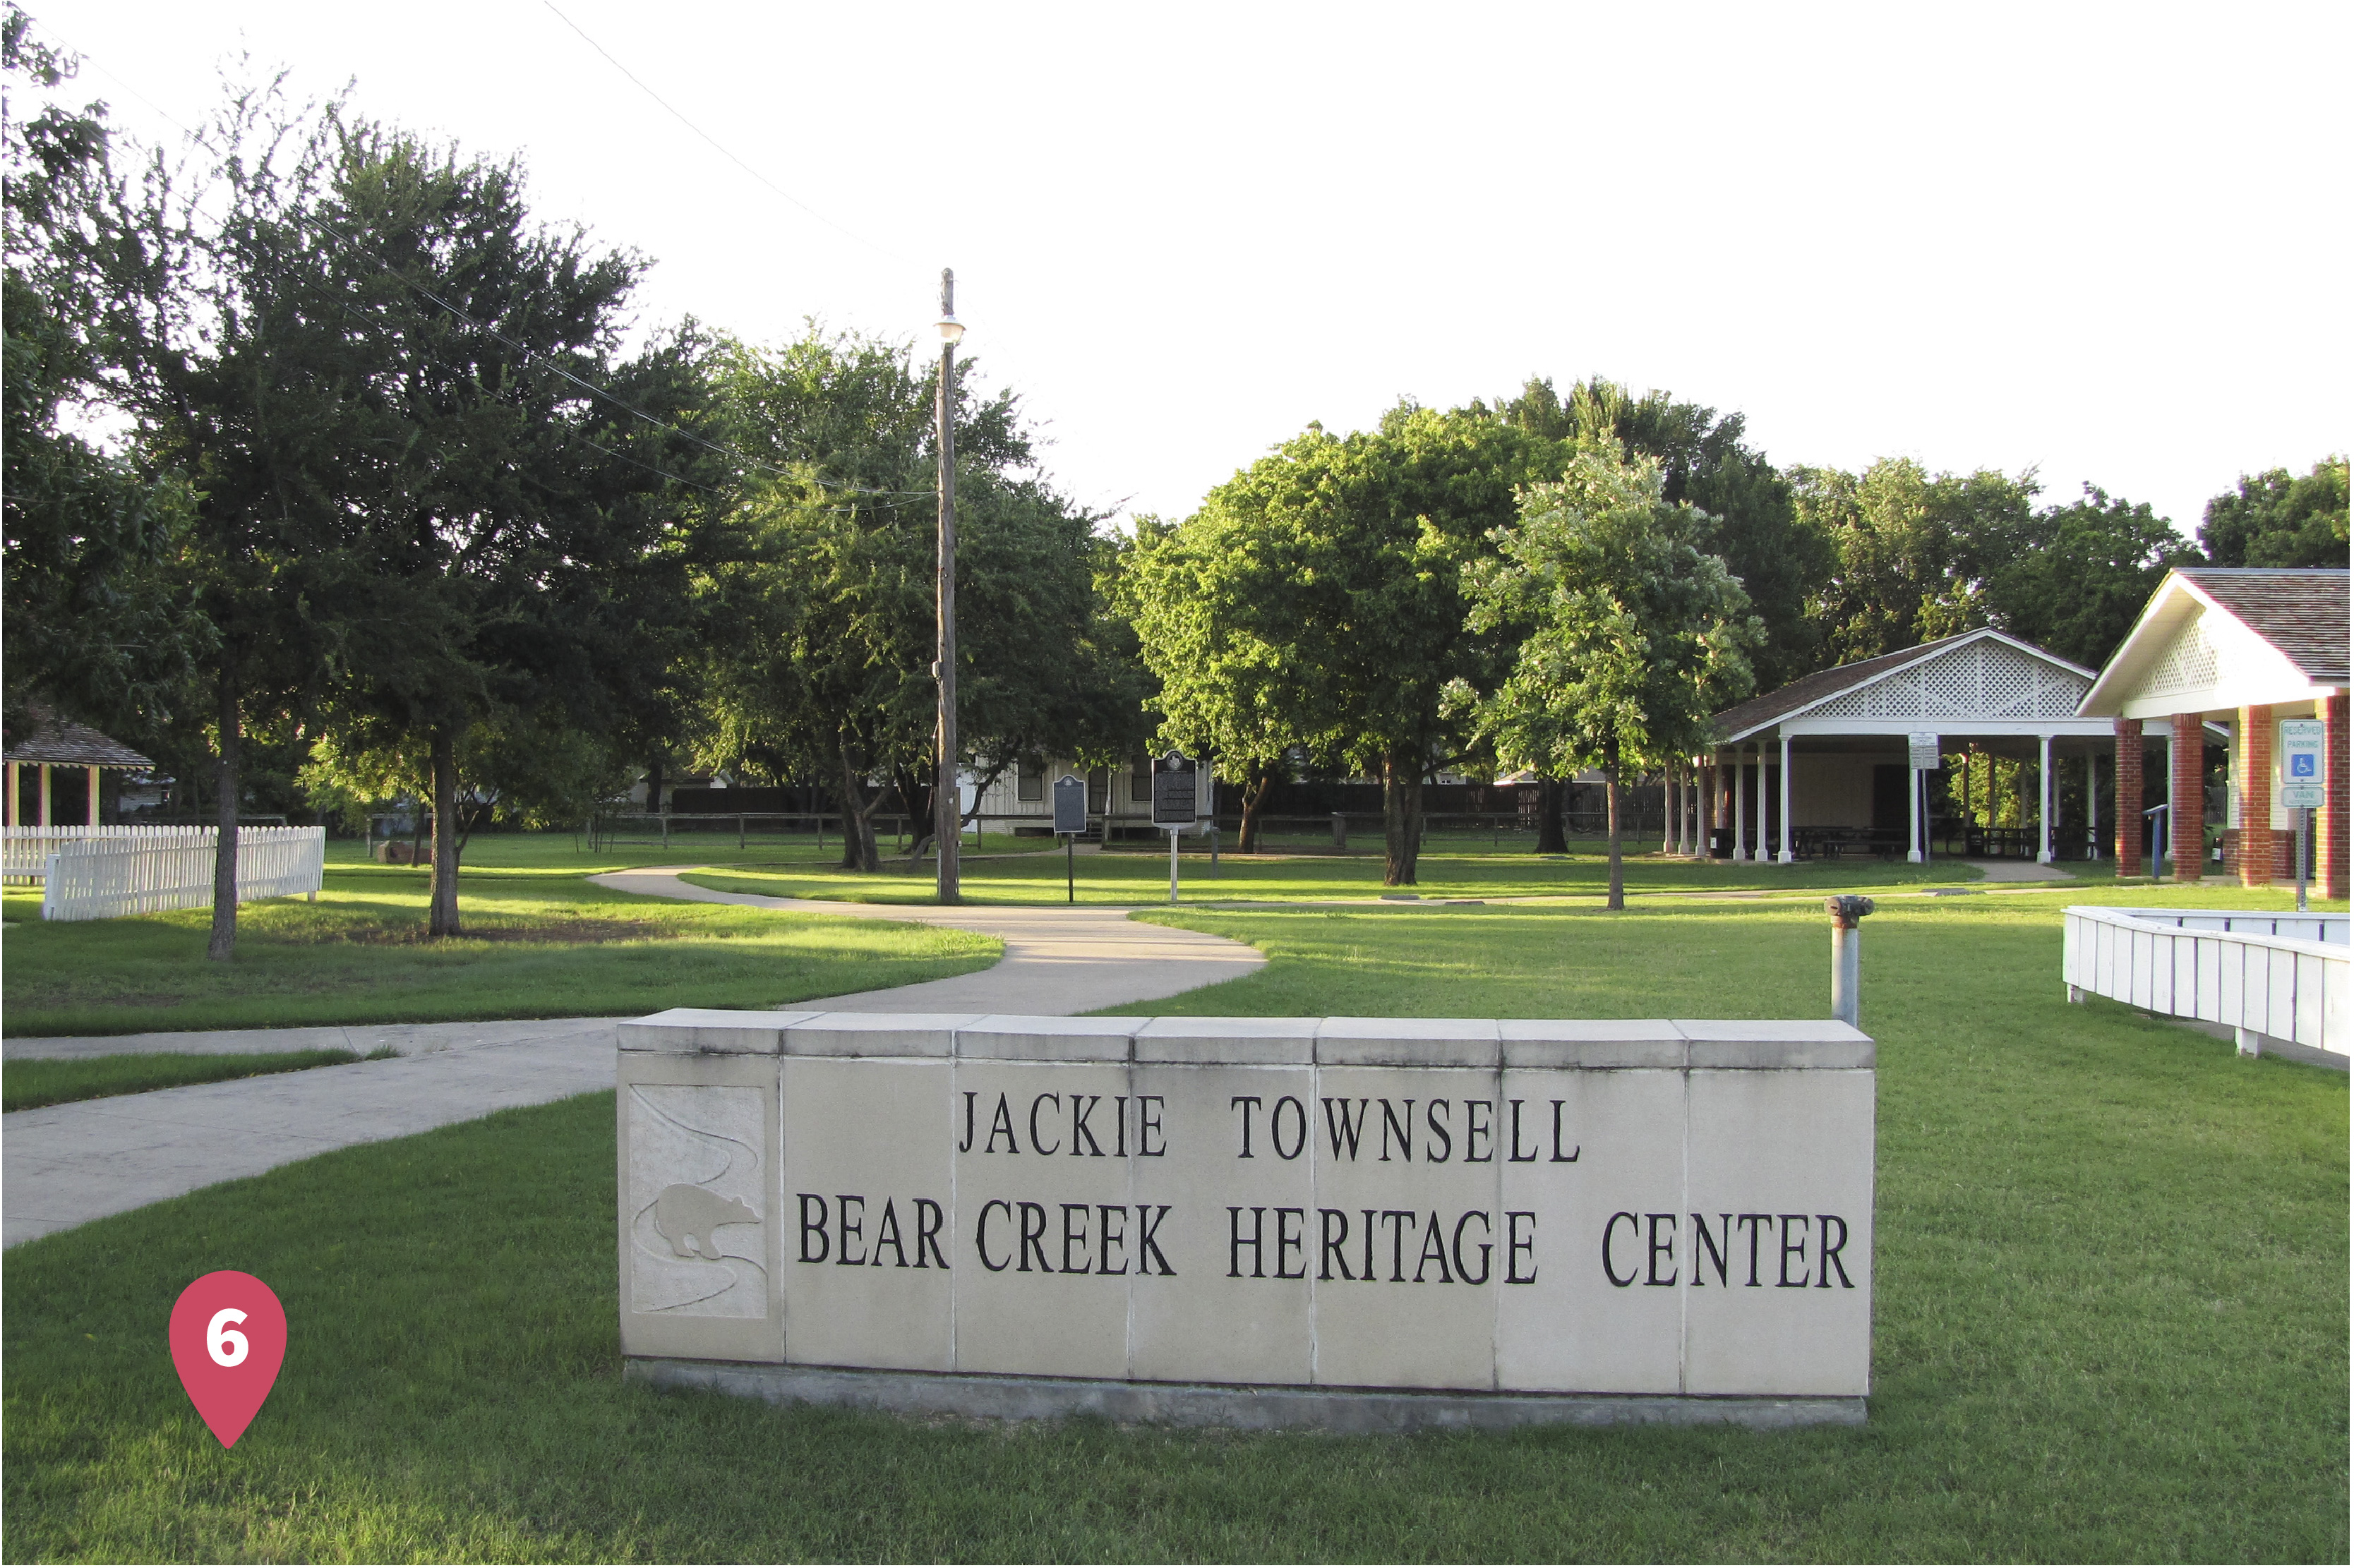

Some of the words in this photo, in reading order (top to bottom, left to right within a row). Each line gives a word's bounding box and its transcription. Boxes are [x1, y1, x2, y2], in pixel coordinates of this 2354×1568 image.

[2283, 726, 2321, 735] RESERVED
[2293, 790, 2314, 798] VAN
[958, 1091, 1167, 1159] JACKIE
[1230, 1094, 1581, 1164] TOWNSELL
[795, 1193, 951, 1270] BEAR
[975, 1198, 1178, 1277] CREEK
[1225, 1206, 1539, 1286] HERITAGE
[1601, 1210, 1856, 1289] CENTER
